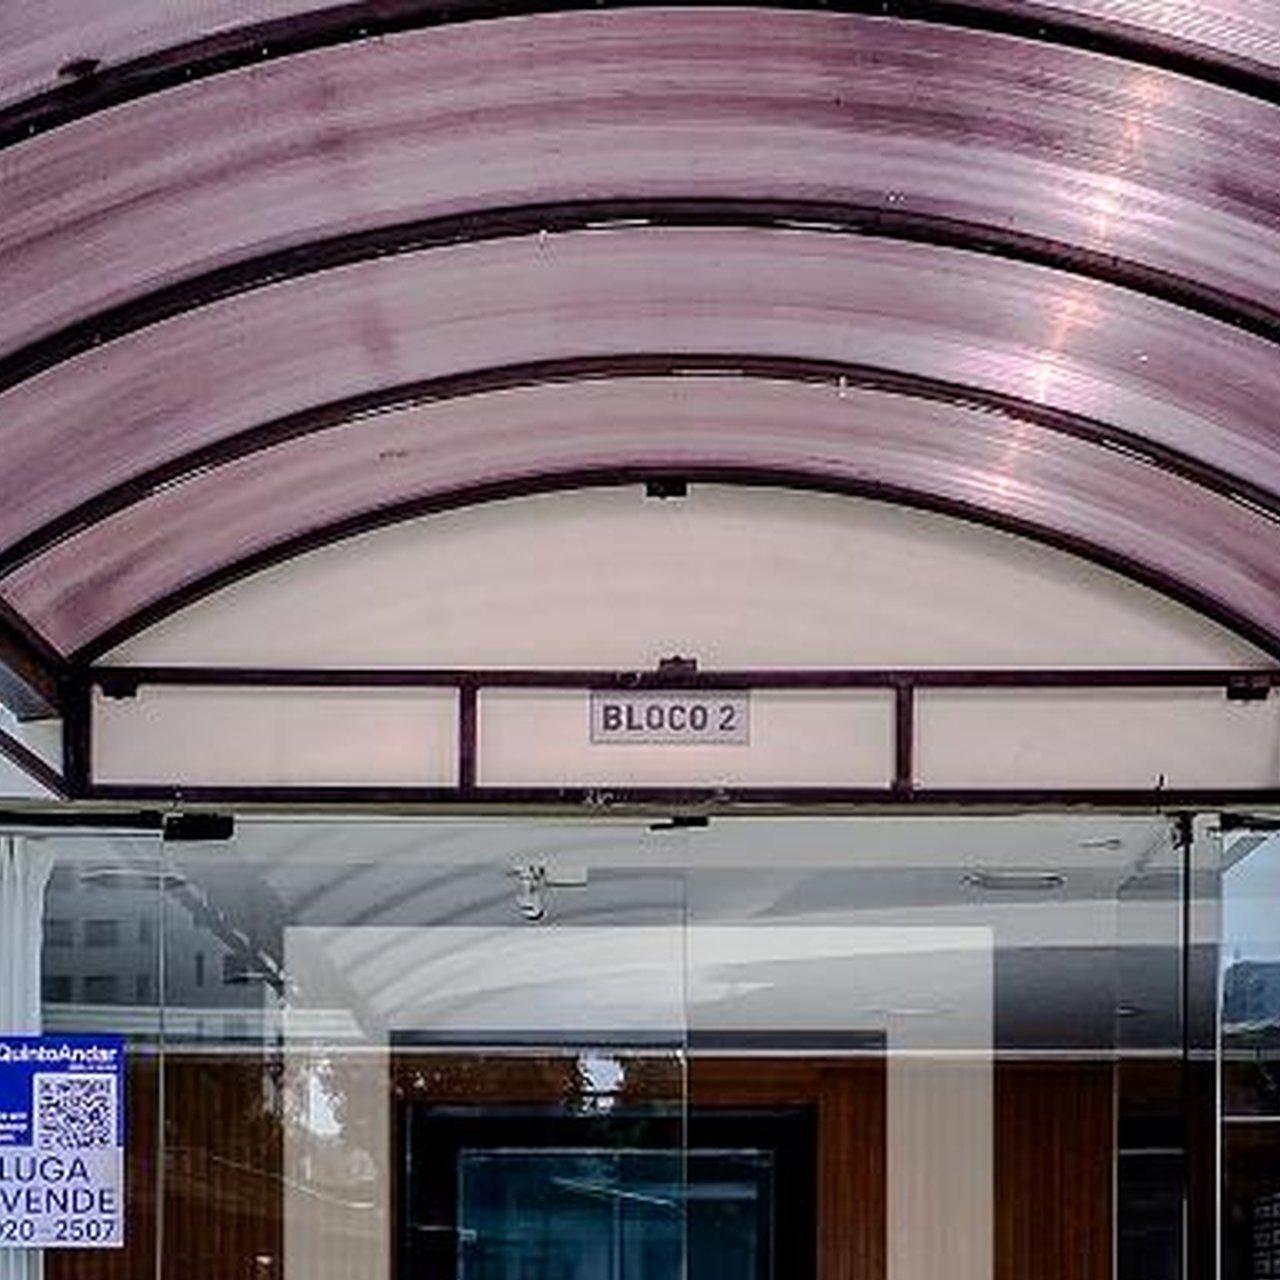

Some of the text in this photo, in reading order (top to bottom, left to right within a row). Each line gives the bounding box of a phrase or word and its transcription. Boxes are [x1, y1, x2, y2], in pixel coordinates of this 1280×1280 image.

[602, 704, 737, 731] BLOCO 2
[0, 1187, 117, 1214] VENDE
[53, 1219, 116, 1241] 2507
